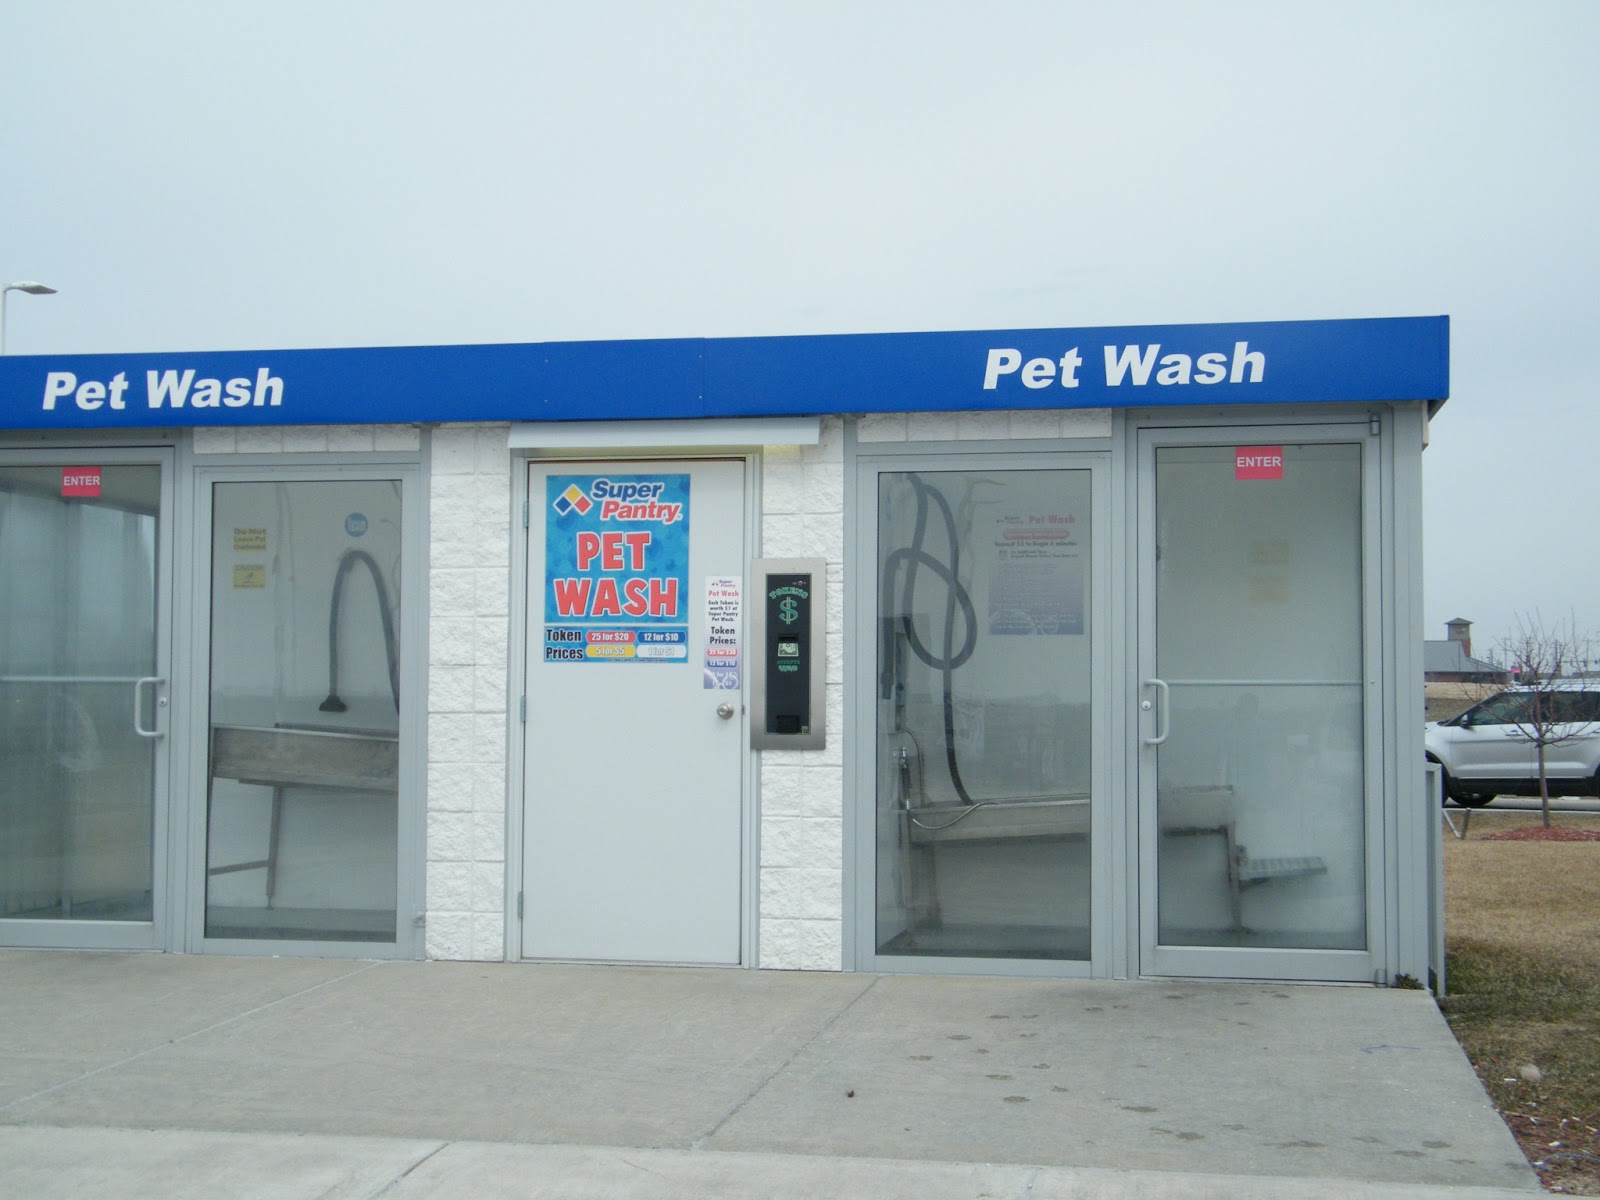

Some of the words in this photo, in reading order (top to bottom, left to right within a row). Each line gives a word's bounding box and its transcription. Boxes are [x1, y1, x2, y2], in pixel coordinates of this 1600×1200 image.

[984, 347, 1082, 390] Pet
[1104, 341, 1266, 387] Wash
[43, 371, 129, 410] Pet
[146, 367, 284, 408] Wash
[1237, 455, 1282, 468] ENTER
[63, 475, 101, 487] ENTER
[591, 479, 664, 501] Super
[600, 500, 682, 524] Pantry
[1028, 515, 1046, 524] Pet
[1048, 514, 1075, 524] Wash
[577, 531, 651, 571] PET
[553, 577, 678, 617] WASH
[769, 587, 809, 599] TOKENS
[546, 629, 582, 642] Token
[591, 632, 602, 641] 25
[602, 632, 613, 641] for
[614, 632, 629, 641] $20
[644, 632, 653, 641] 12
[653, 632, 664, 641] for
[665, 632, 679, 641] $10
[711, 626, 736, 635] Token
[709, 636, 736, 644] Prices:
[545, 646, 584, 660] Prices
[596, 646, 601, 655] 5
[602, 646, 613, 655] for
[614, 646, 625, 655] $5
